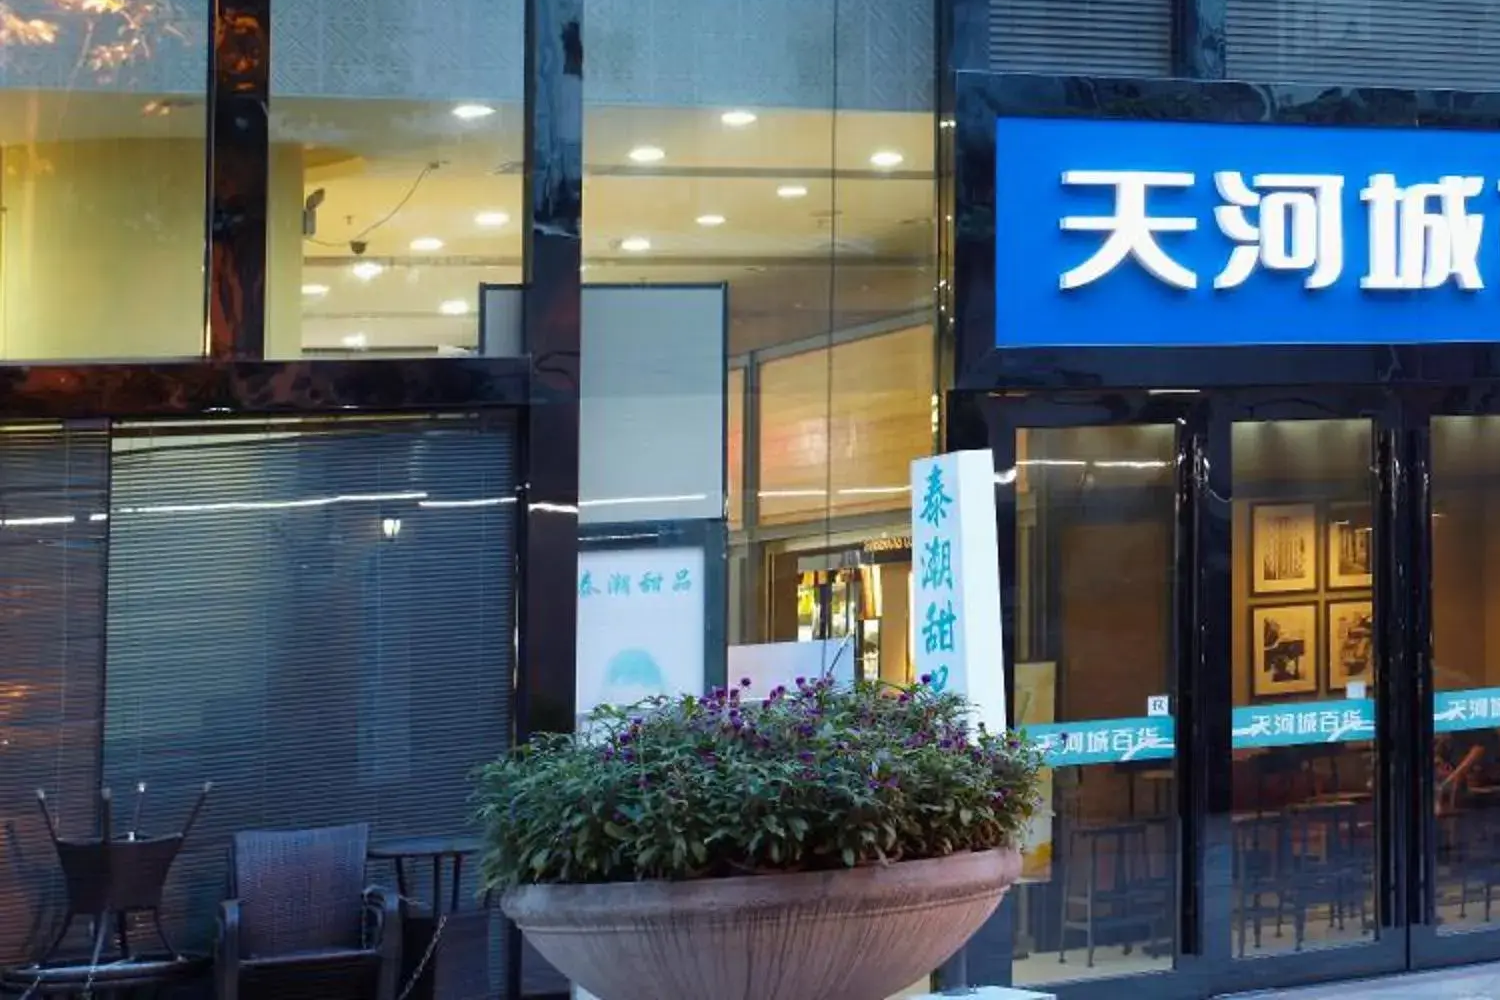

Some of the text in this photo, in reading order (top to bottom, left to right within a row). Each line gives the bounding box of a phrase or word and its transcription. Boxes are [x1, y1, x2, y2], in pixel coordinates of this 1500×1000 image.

[1252, 710, 1362, 737] 天河城百货
